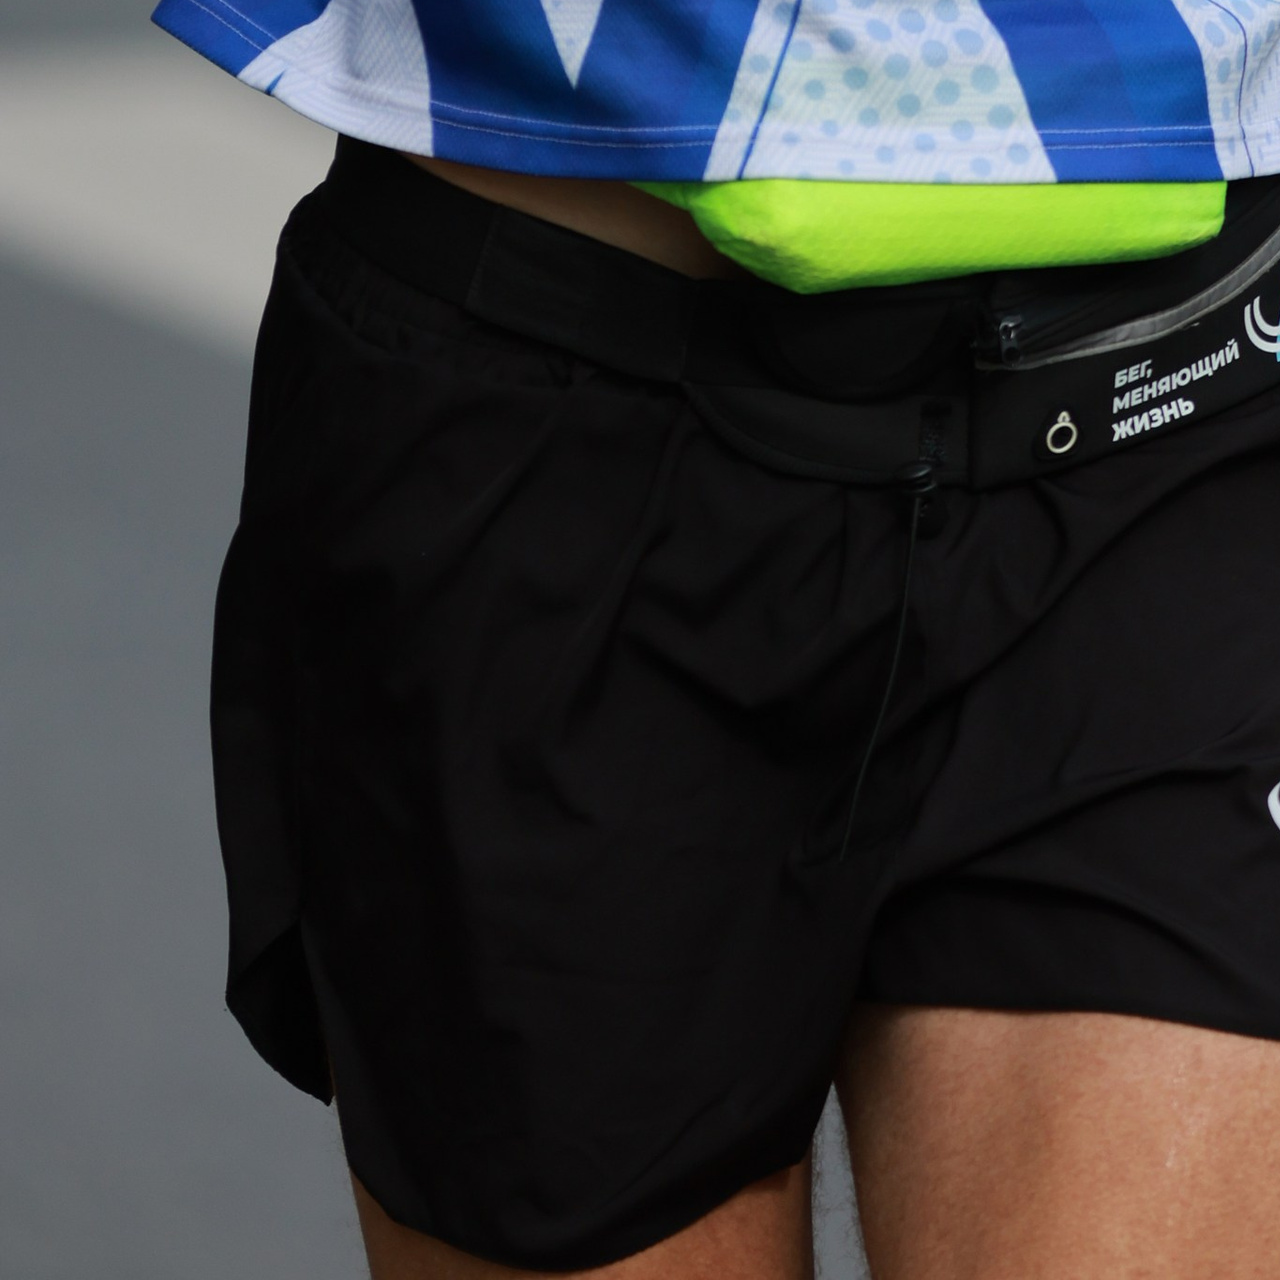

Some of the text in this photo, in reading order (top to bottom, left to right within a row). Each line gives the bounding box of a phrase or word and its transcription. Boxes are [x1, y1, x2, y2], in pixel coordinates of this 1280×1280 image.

[1112, 339, 1241, 414] МЕНЯЮЩИЙ
[1114, 359, 1153, 389] БЕГ,
[1112, 397, 1195, 442] ЖИЗНЬ
